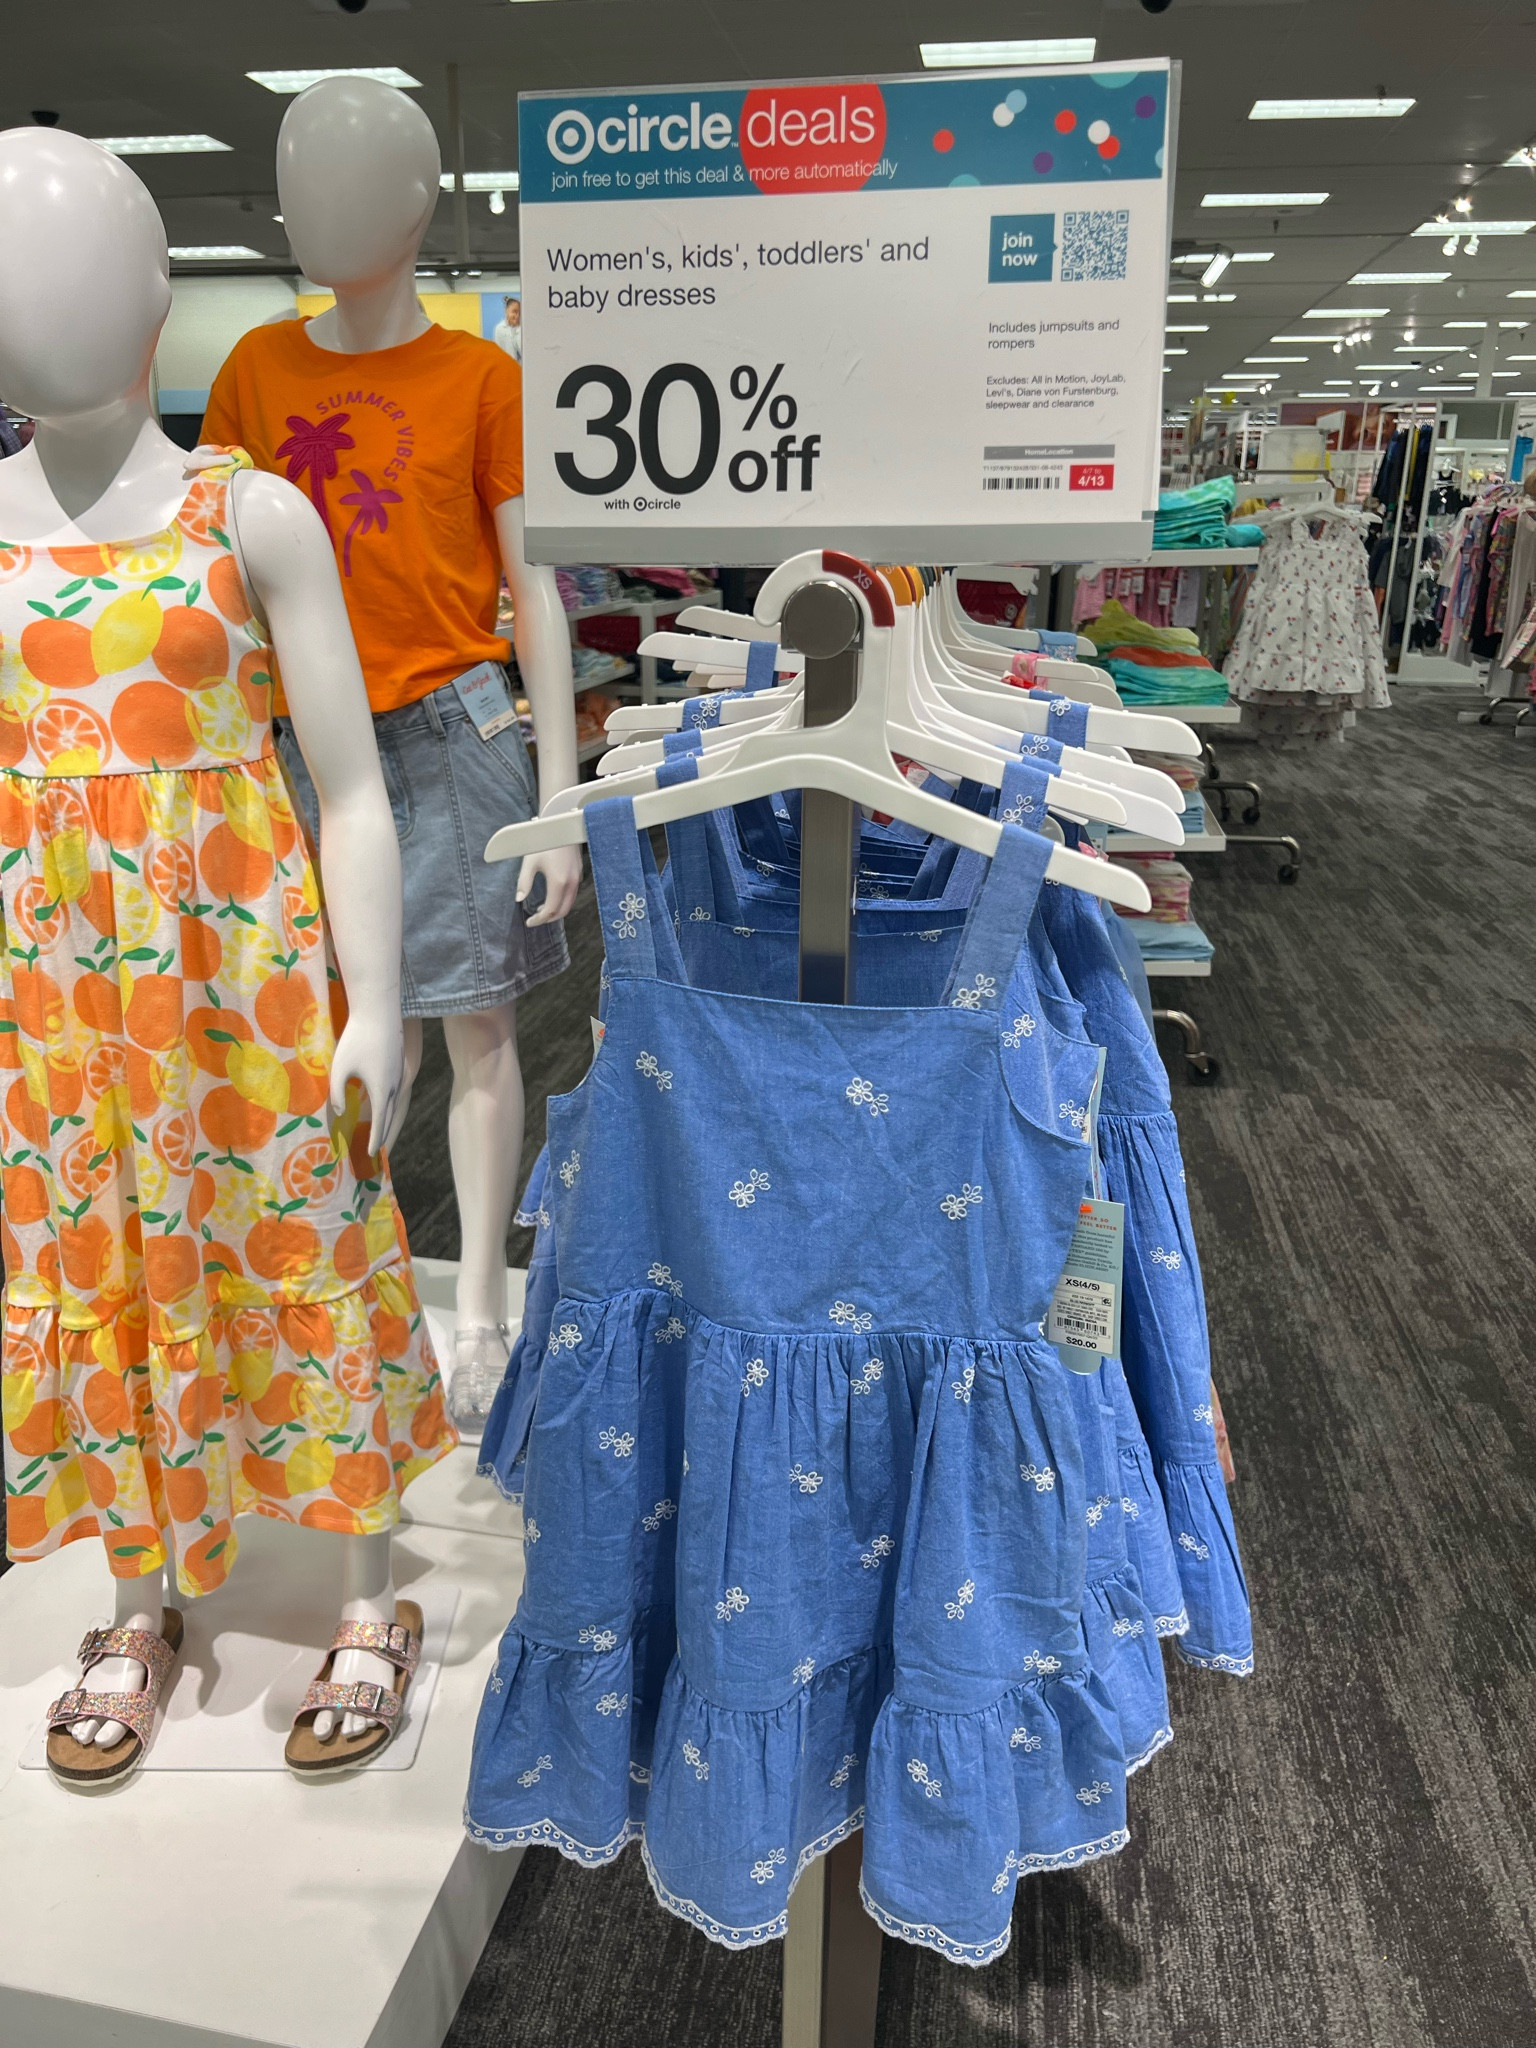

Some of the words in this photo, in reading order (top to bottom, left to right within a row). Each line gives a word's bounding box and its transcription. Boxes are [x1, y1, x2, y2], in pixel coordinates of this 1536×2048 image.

[747, 95, 875, 148] deals
[551, 171, 578, 193] join
[582, 170, 611, 188] free
[616, 170, 631, 187] to
[635, 169, 660, 190] get
[664, 167, 692, 185] this
[695, 165, 728, 184] deal
[733, 164, 745, 183] &
[749, 166, 790, 181] more
[794, 158, 898, 180] automatically
[1001, 232, 1033, 251] join
[546, 246, 673, 273] Women's,
[681, 243, 749, 270] kids',
[757, 238, 871, 267] toddlers'
[880, 236, 930, 262] and
[1002, 253, 1038, 267] now
[547, 285, 609, 314] baby
[617, 284, 716, 308] dresses
[988, 322, 1036, 334] Includes
[1039, 320, 1095, 335] jumpsuits
[1098, 319, 1120, 331] and
[988, 339, 1035, 351] rompers
[986, 376, 1029, 385] Excludes:
[1031, 375, 1042, 385] All
[1044, 375, 1053, 384] in
[1055, 374, 1088, 385] Motion,
[1090, 374, 1126, 386] JoyLab,
[986, 388, 1014, 398] Levi's,
[1016, 388, 1042, 397] Diane
[985, 401, 1030, 410] sleepwear
[1032, 400, 1049, 409] and
[1051, 399, 1095, 409] clearance
[315, 390, 406, 422] SUMMER
[383, 425, 415, 482] VIBES
[728, 434, 821, 494] off
[1078, 475, 1105, 487] 4/13
[604, 499, 630, 510] with
[853, 568, 873, 590] XS
[1065, 1278, 1100, 1291] XS(4/5)
[1065, 1336, 1097, 1349] $20.00
